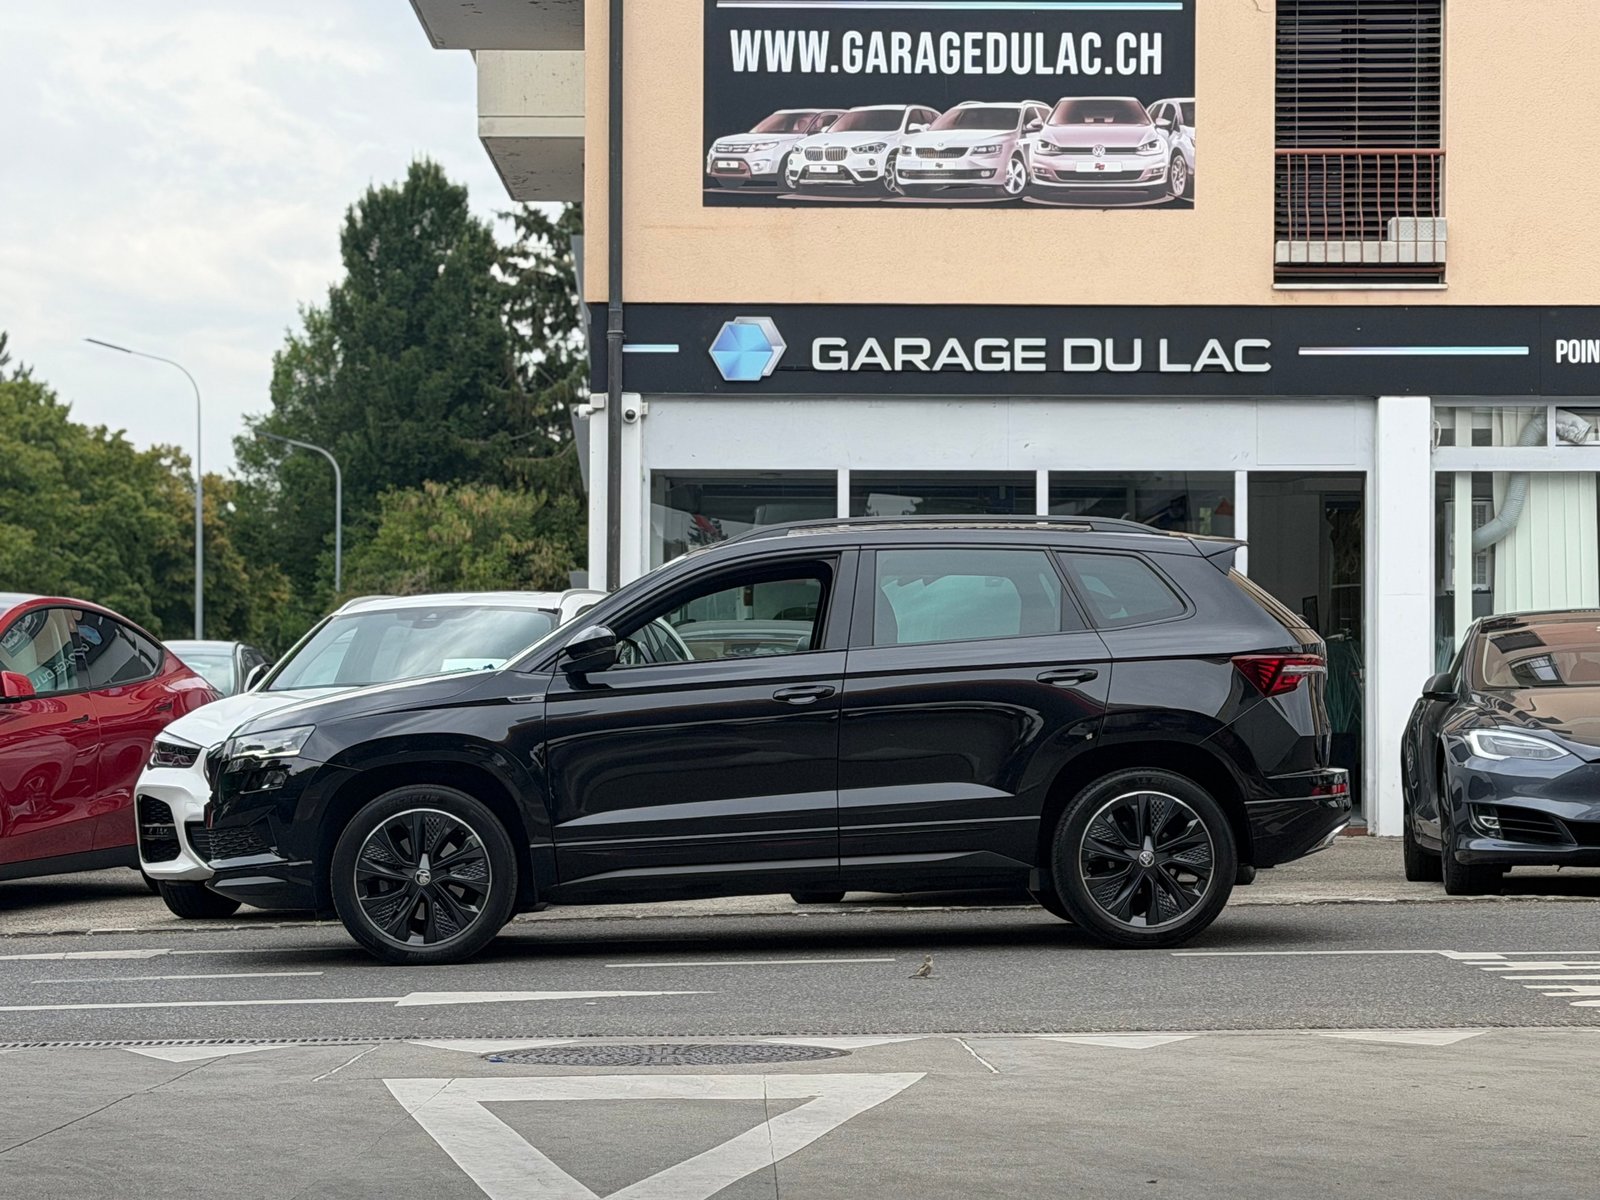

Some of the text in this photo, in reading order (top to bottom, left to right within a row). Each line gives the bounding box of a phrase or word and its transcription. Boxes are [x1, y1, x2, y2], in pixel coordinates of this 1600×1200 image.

[729, 29, 1162, 76] WWW.GARAGEDULAC.CH
[811, 337, 1272, 374] GARAGE DU LAC
[1555, 338, 1600, 364] POIN
